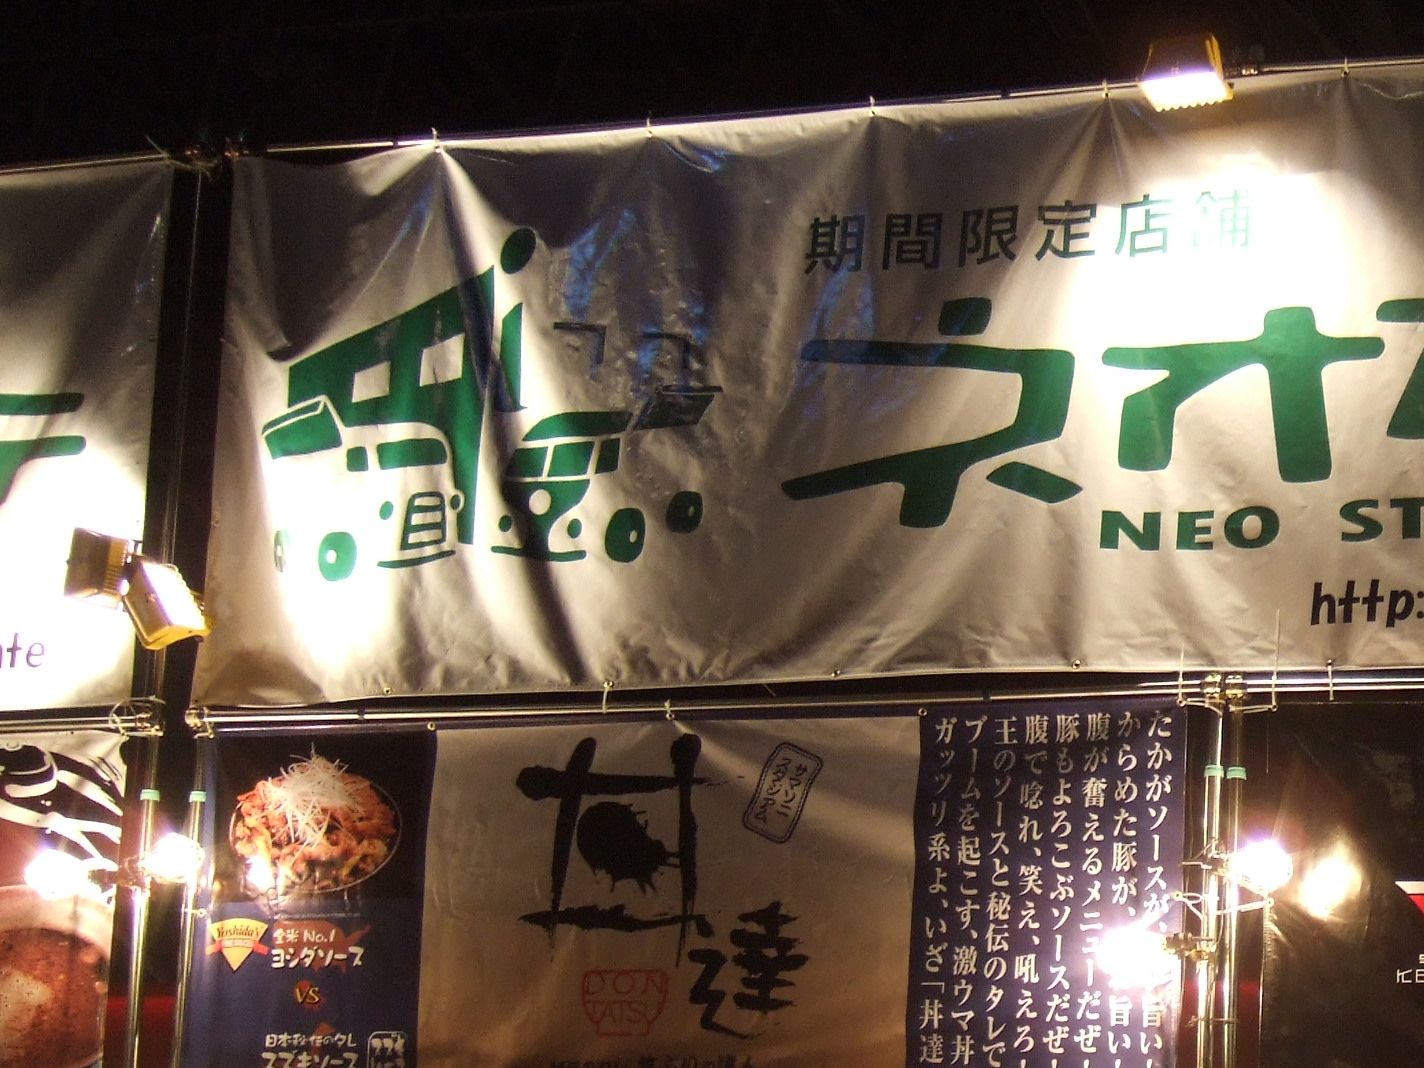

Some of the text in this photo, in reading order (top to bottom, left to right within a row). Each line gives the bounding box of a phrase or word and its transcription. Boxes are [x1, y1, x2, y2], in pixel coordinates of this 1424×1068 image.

[803, 189, 1252, 275] 期間限定店舗
[1100, 505, 1280, 551] NEO
[271, 946, 366, 969] ヨシダソース
[296, 986, 321, 1004] VS
